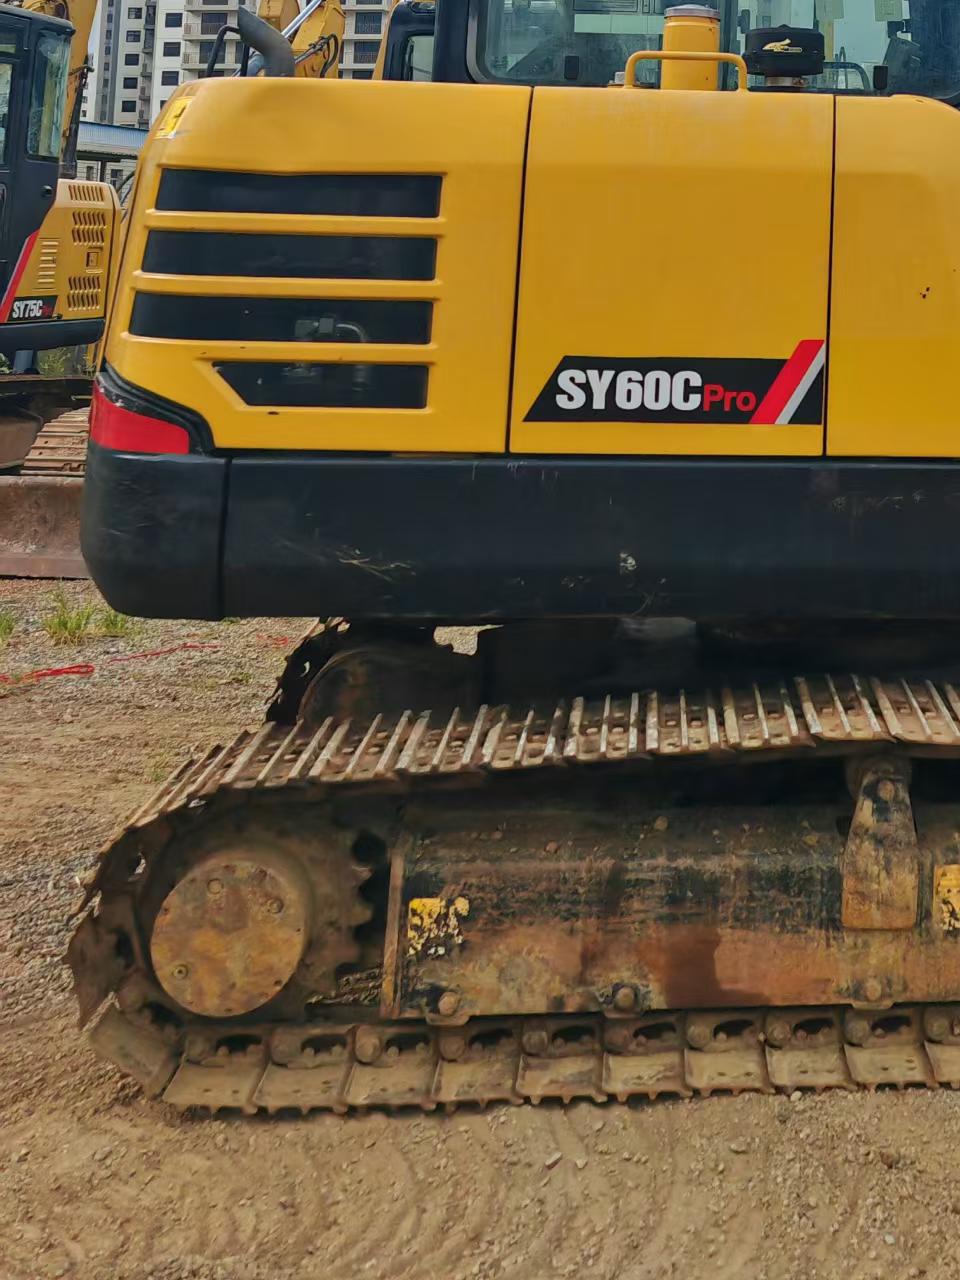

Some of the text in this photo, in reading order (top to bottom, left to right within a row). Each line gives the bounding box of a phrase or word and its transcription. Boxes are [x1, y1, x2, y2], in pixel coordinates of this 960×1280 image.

[12, 299, 43, 318] SY75C
[555, 369, 757, 412] SY60C Pro
